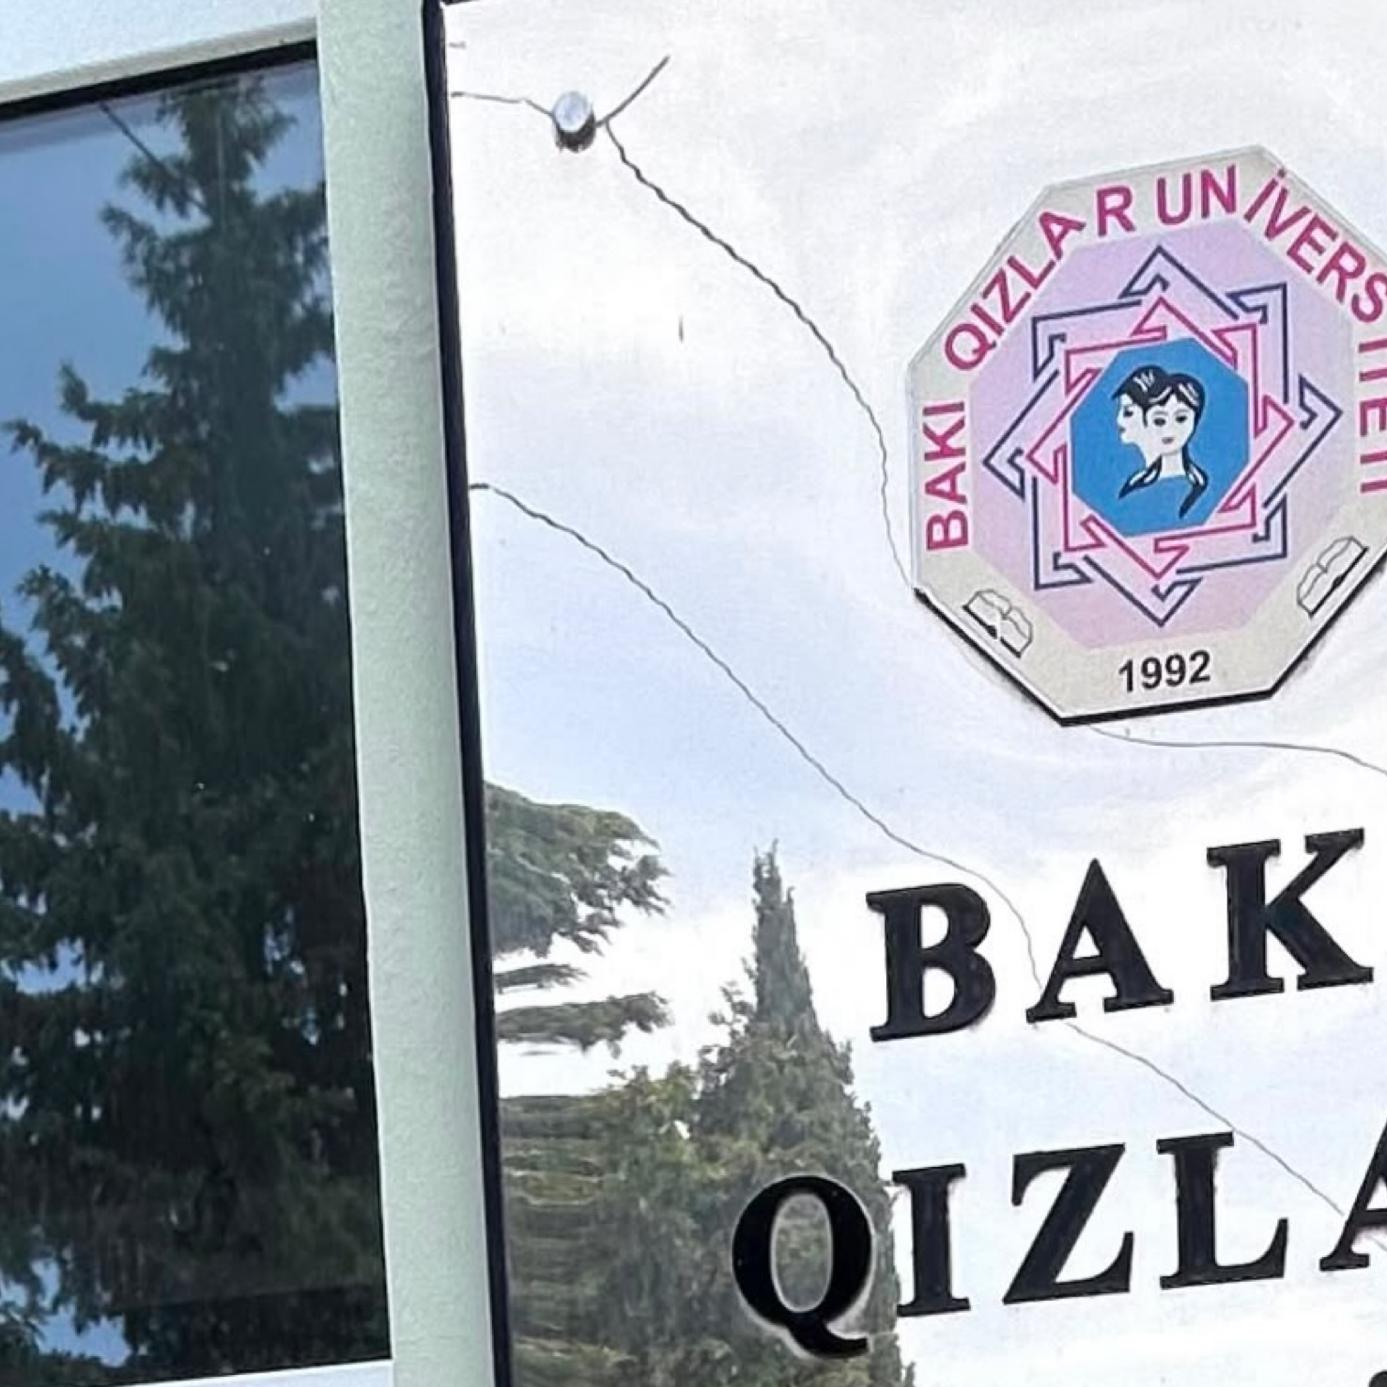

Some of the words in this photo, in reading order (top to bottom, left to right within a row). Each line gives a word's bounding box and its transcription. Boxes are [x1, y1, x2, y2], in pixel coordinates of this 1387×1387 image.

[944, 185, 1136, 374] QIZLAR
[922, 400, 969, 552] BAKI
[1117, 649, 1212, 693] 1992
